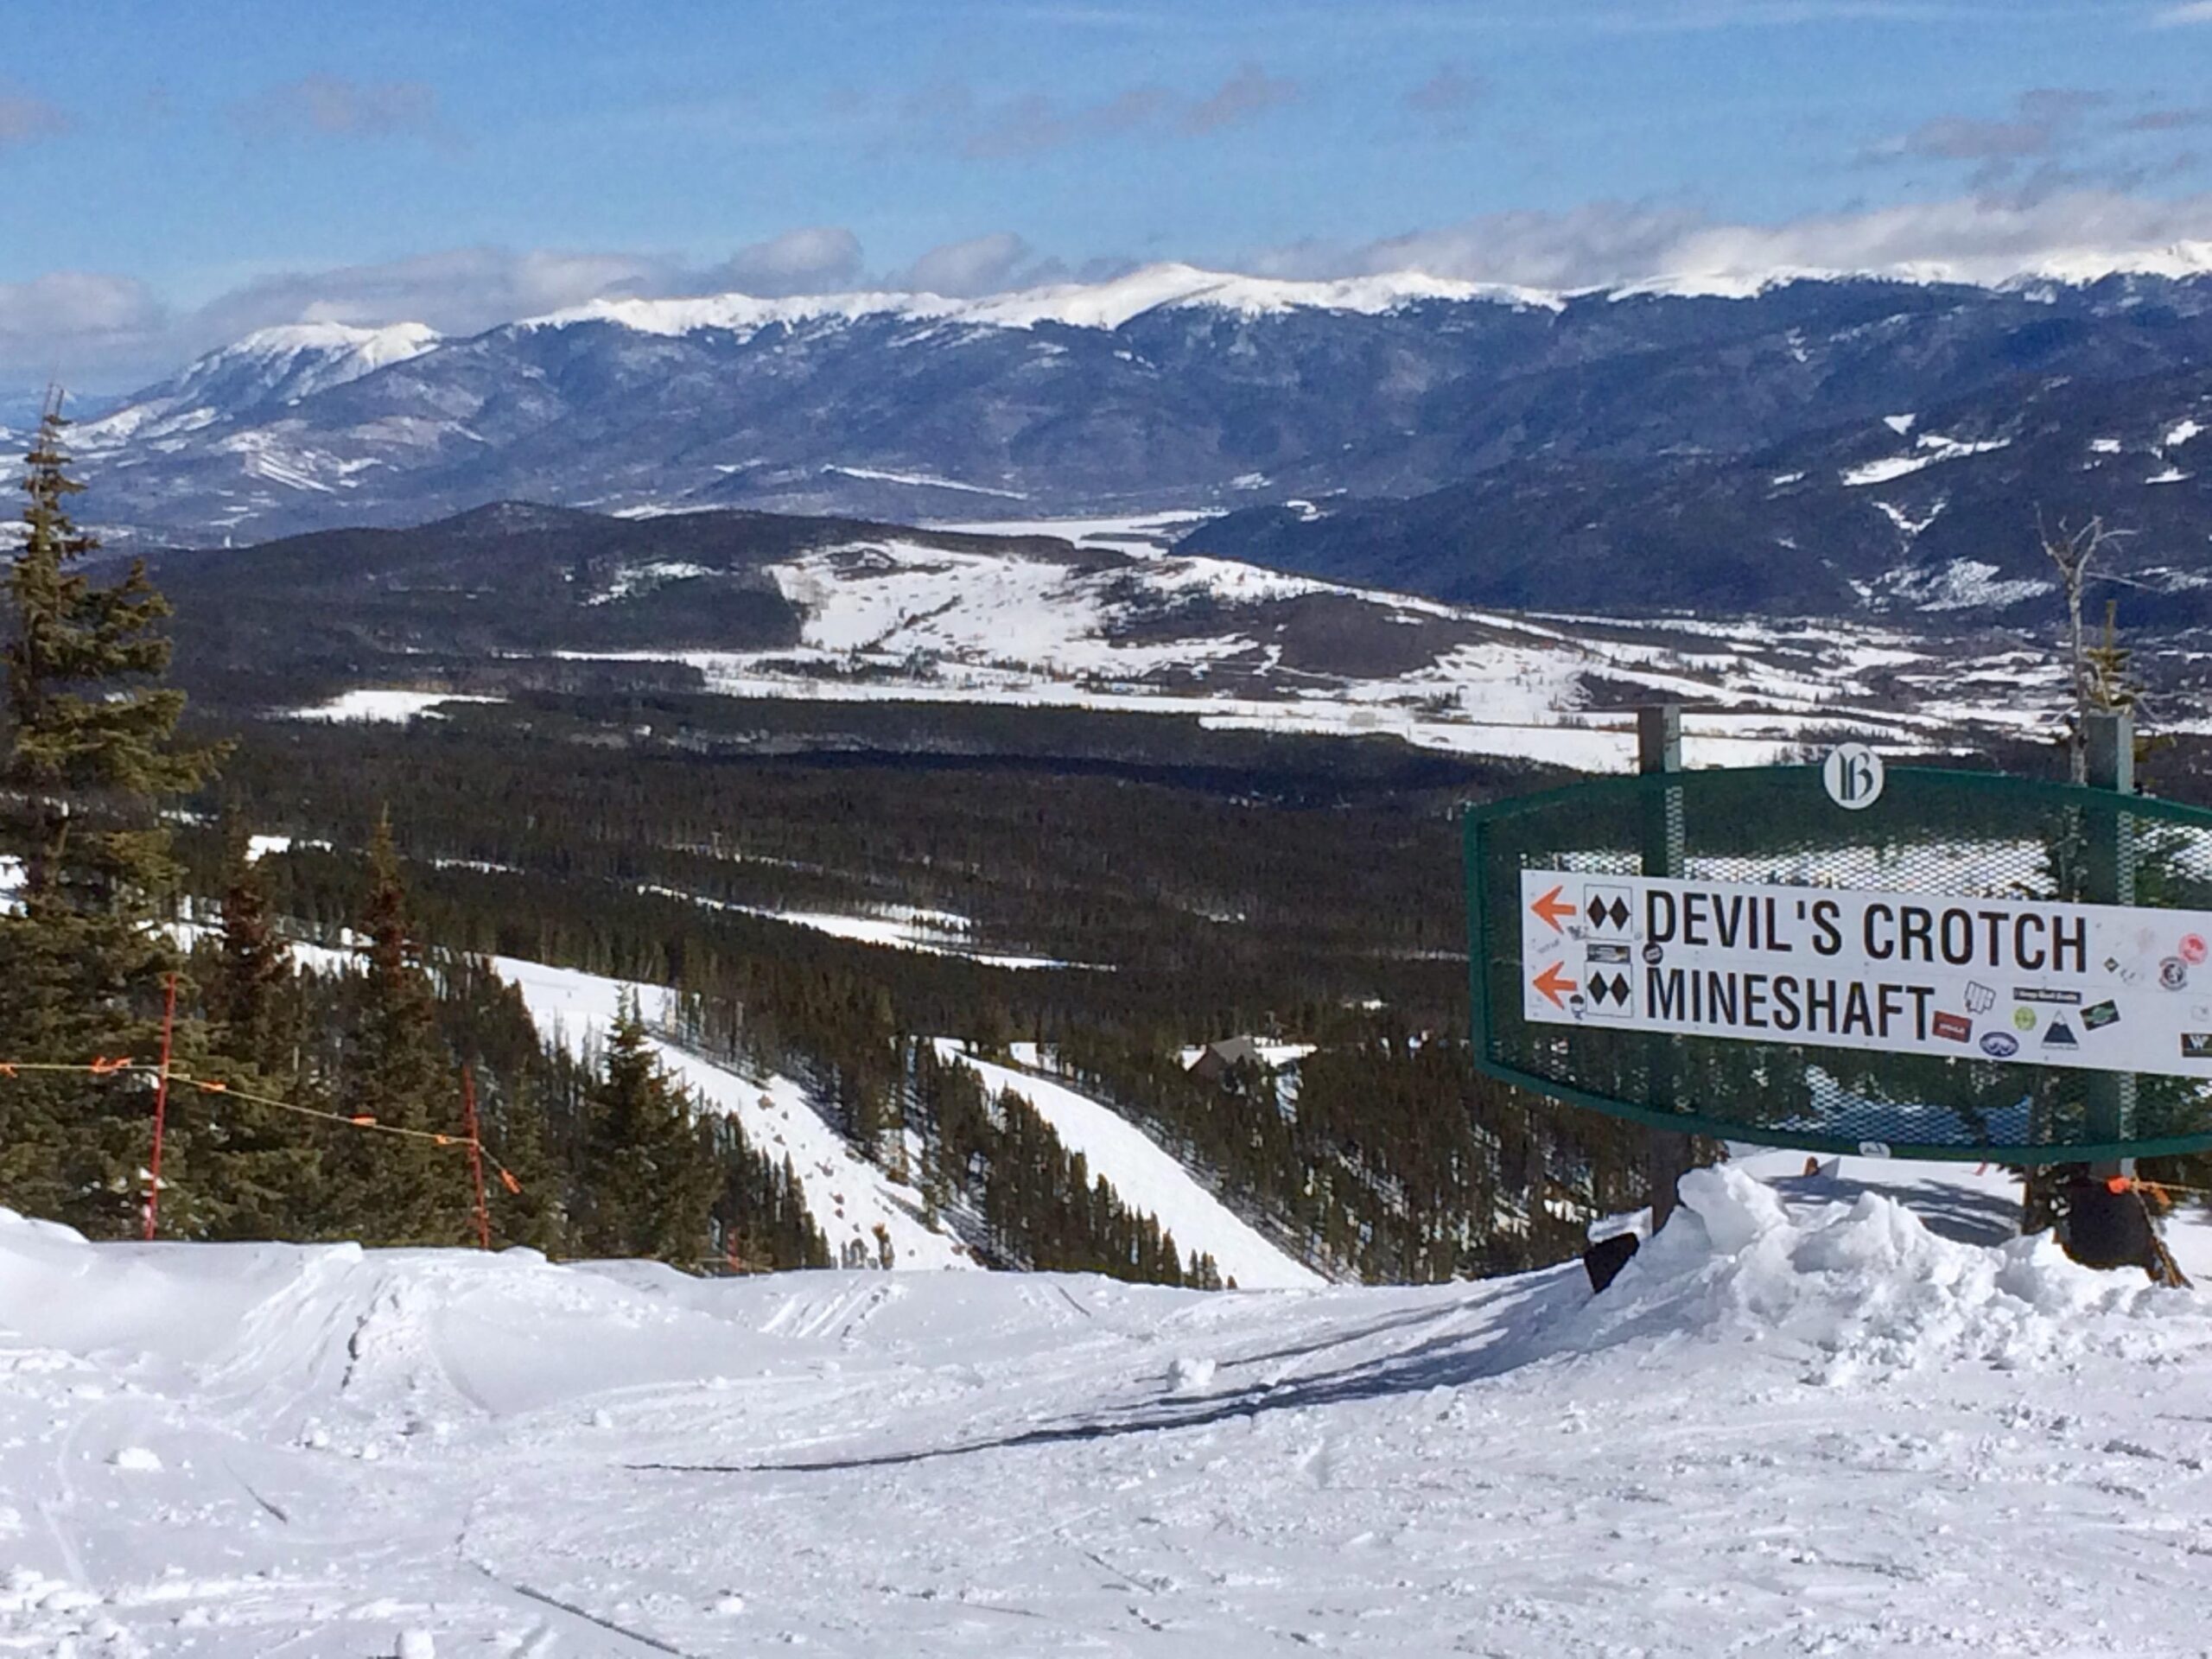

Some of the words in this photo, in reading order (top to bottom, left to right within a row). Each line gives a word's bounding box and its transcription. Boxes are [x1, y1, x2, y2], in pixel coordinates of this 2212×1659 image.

[1646, 889, 1842, 956] DEVIL'S
[1864, 903, 2087, 973] CROTCH
[1647, 966, 1936, 1041] MINESHAFT
